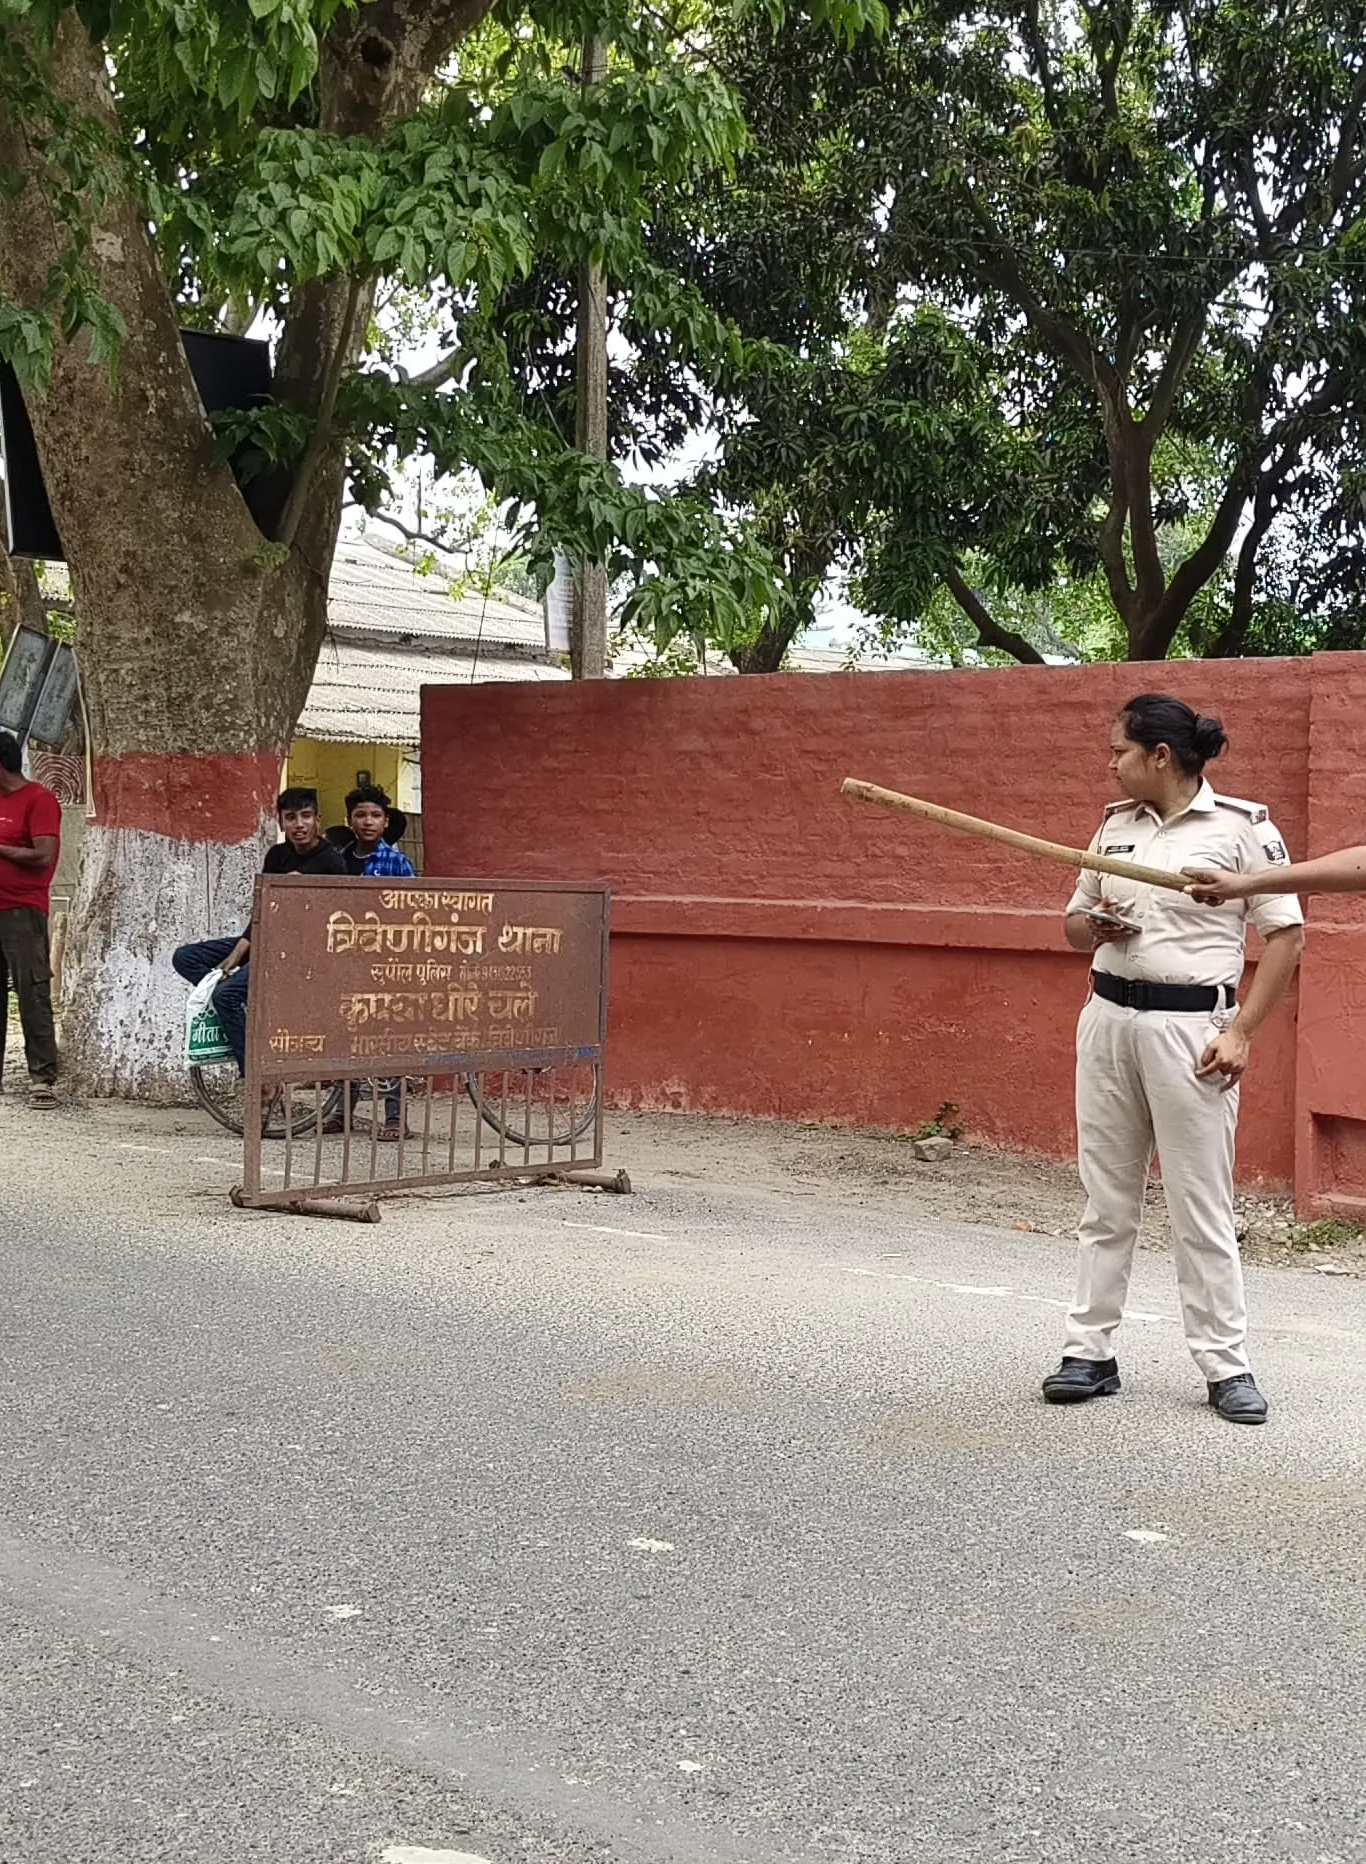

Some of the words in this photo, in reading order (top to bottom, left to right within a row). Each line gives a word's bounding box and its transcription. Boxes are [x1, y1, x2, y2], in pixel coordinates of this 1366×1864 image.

[441, 891, 495, 915] स्वागत
[326, 910, 488, 954] त्रिवेणीगंज
[497, 920, 564, 954] थाना
[370, 957, 414, 986] सुपौल
[416, 958, 454, 986] पुलिस
[430, 981, 483, 1022] धीरे
[192, 1021, 220, 1044] गीता
